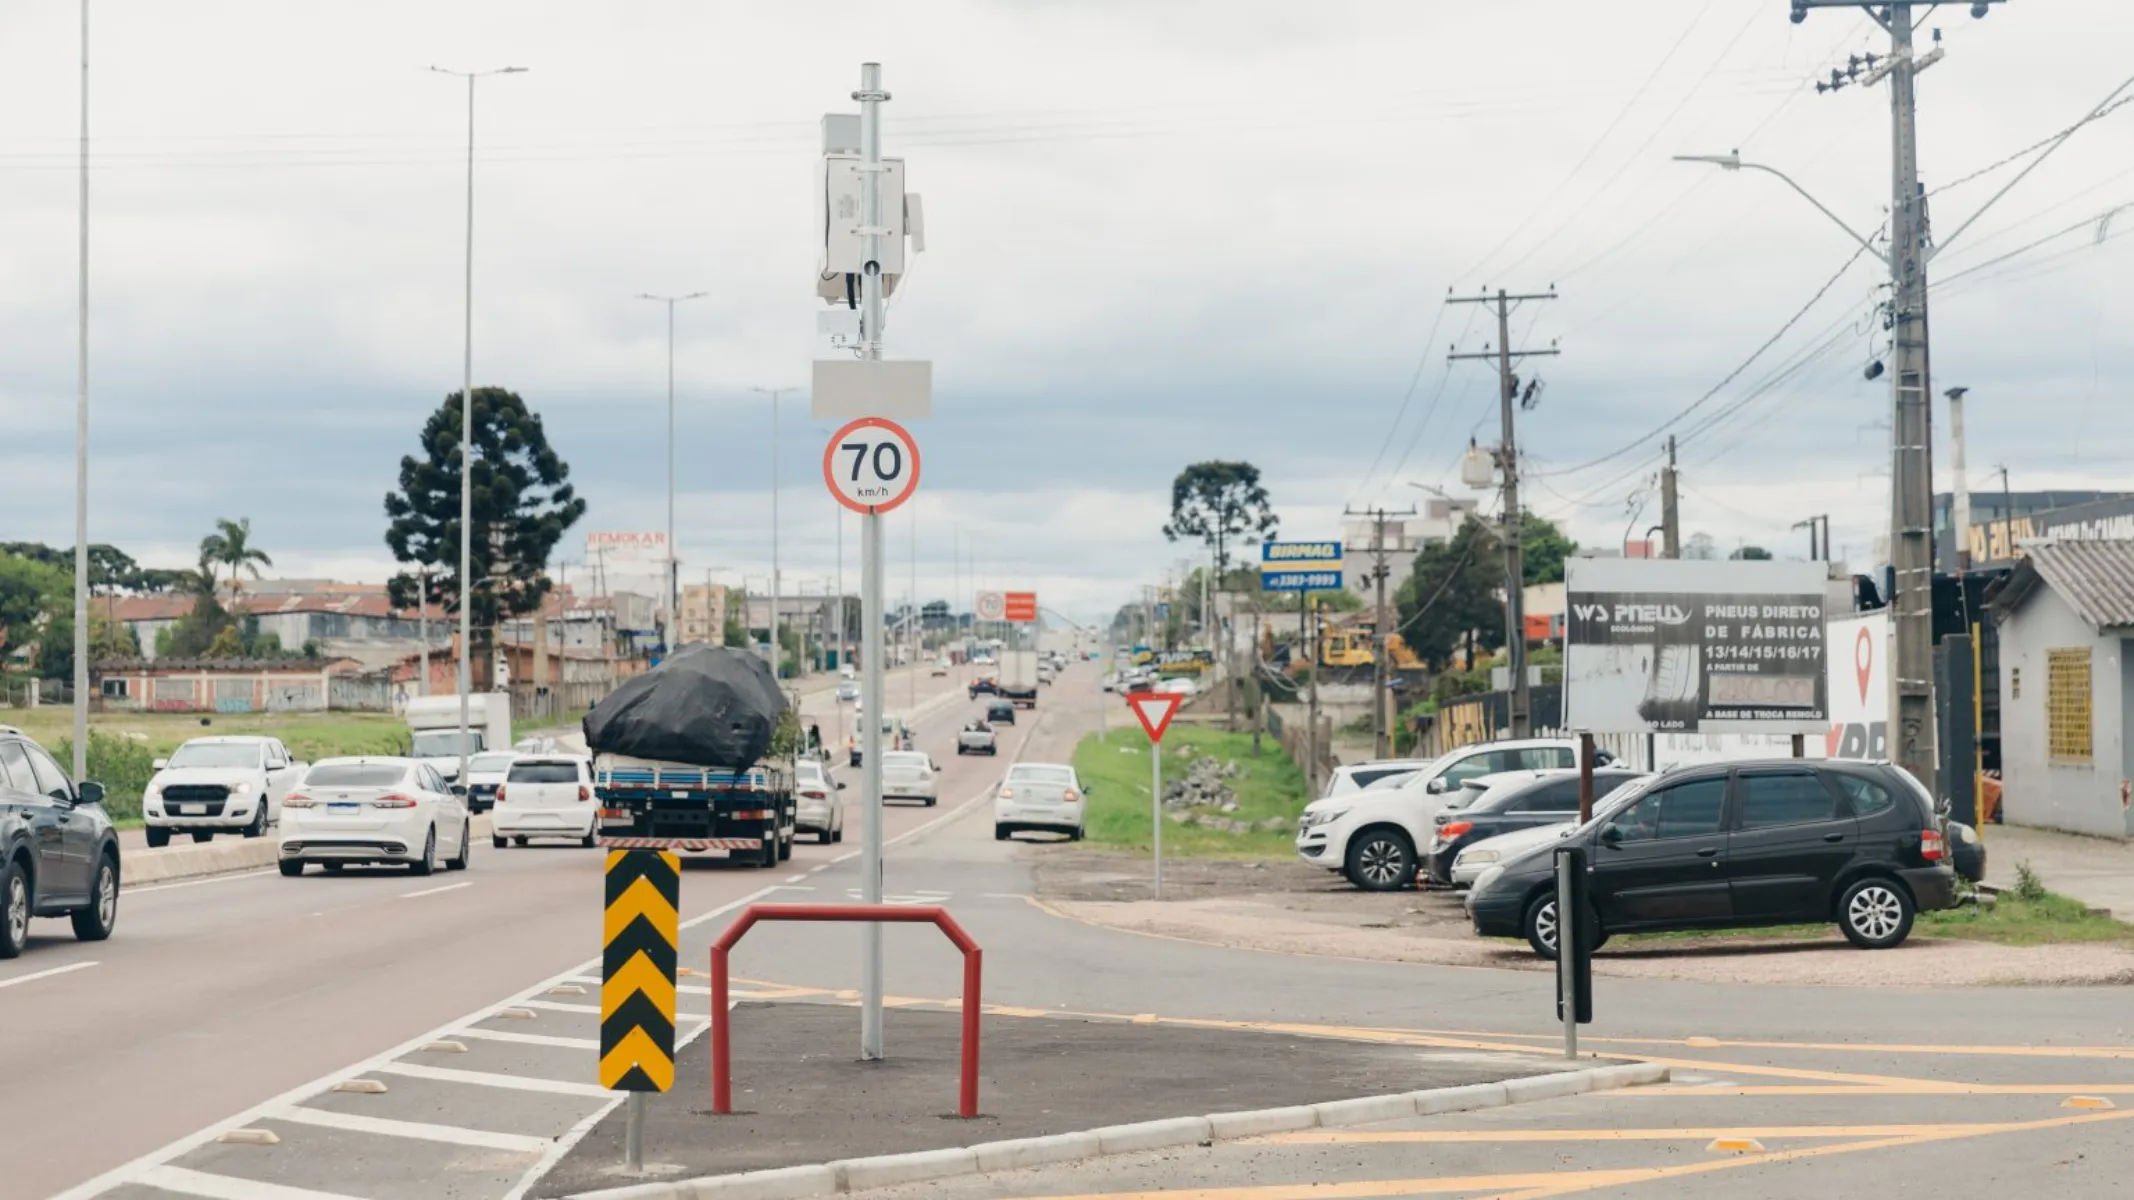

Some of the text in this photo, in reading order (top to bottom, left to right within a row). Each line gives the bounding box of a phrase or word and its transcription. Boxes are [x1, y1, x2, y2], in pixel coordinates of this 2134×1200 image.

[842, 442, 901, 481] 70
[857, 487, 889, 496] km/h
[1269, 545, 1334, 558] BIRMAQ
[1614, 604, 1692, 625] PNEUS
[1705, 605, 1820, 619] PNEUS DIRETO
[1705, 623, 1820, 639] DE FÁBRICA
[1705, 645, 1820, 660] 13/14/15/16/17
[1706, 663, 1759, 672] A PARTIR DE
[1706, 710, 1823, 719] A BASE DE TROCA REMOLD
[1661, 720, 1685, 729] LADO
